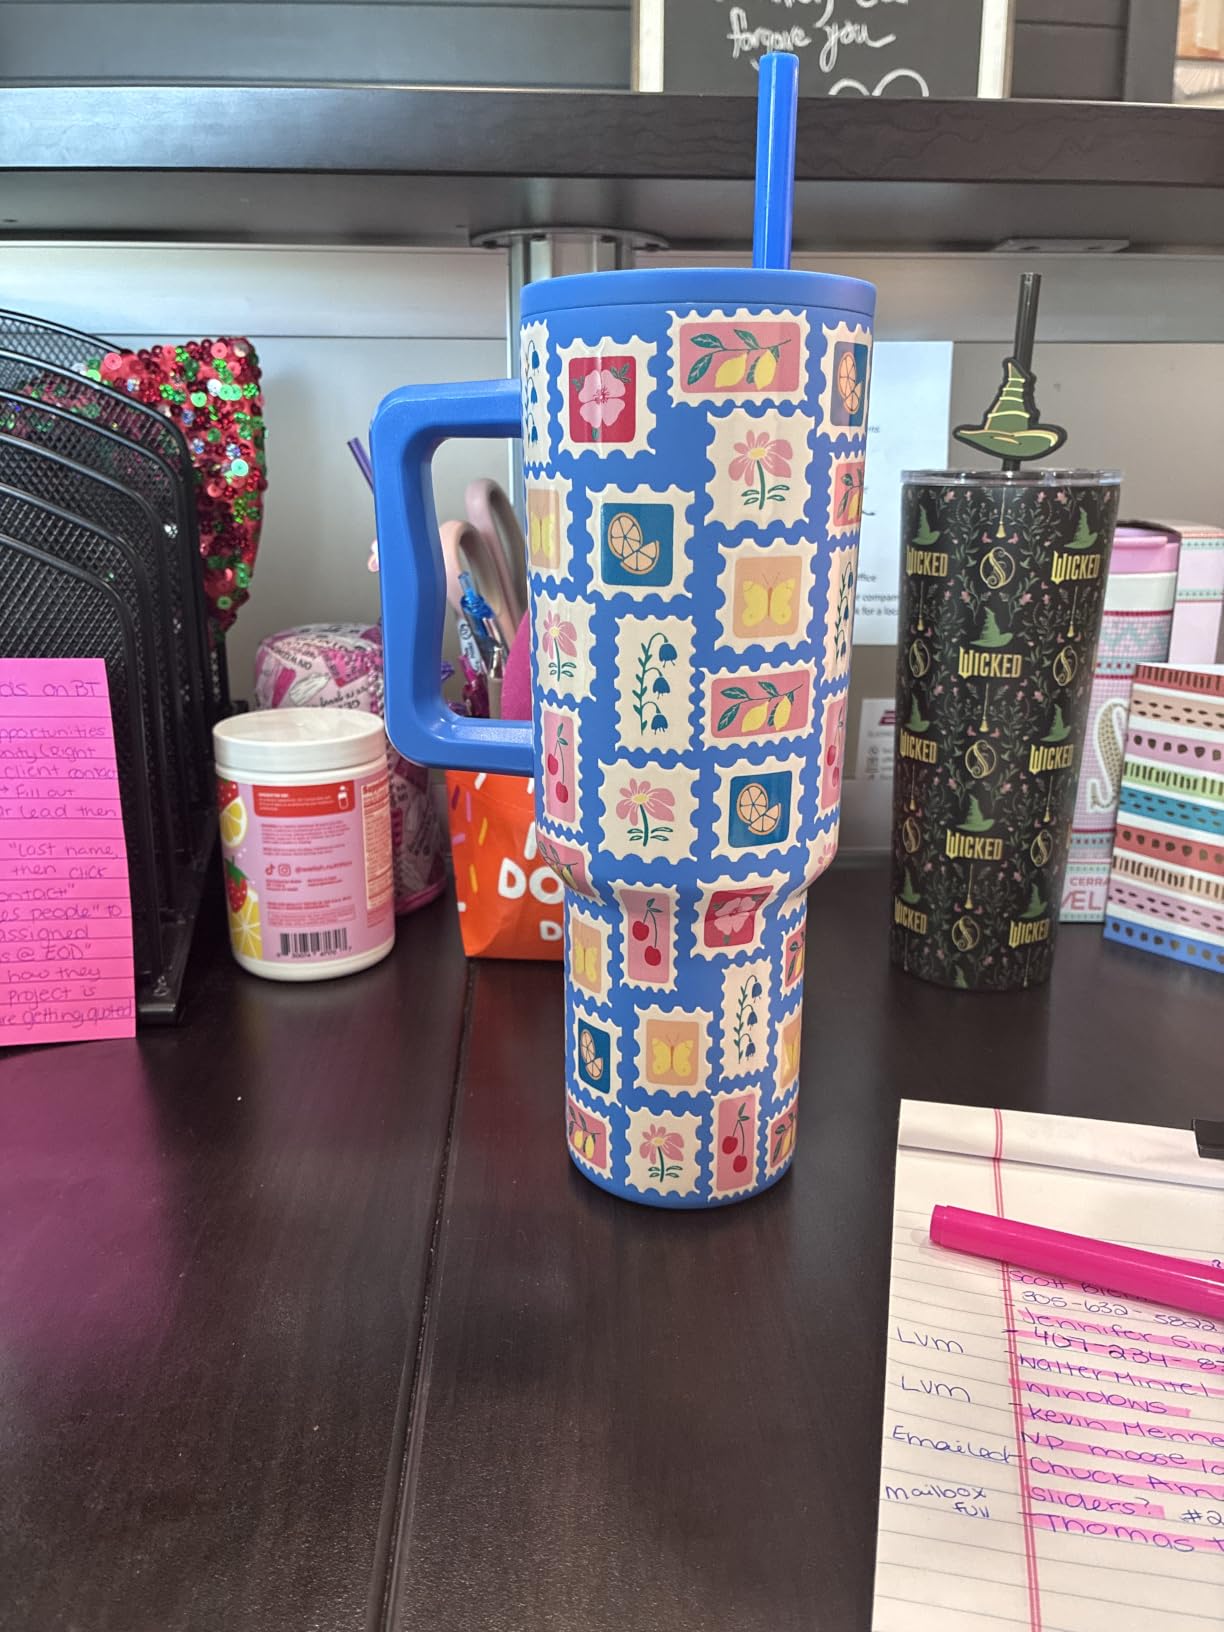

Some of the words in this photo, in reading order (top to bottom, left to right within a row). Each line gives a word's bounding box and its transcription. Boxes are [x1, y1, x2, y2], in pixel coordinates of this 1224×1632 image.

[818, 21, 897, 72] you
[906, 545, 949, 578] WICKED
[1051, 550, 1101, 585] WICKED
[958, 646, 1023, 680] WICKED
[900, 727, 938, 765] WICKED
[1029, 743, 1075, 776] WICKED
[47, 788, 76, 798] out
[76, 805, 117, 817] then
[945, 829, 1004, 861] WICKED
[894, 896, 928, 936] WICKED
[1008, 918, 1050, 949] WICKED
[1025, 1307, 1151, 1343] Jennifer
